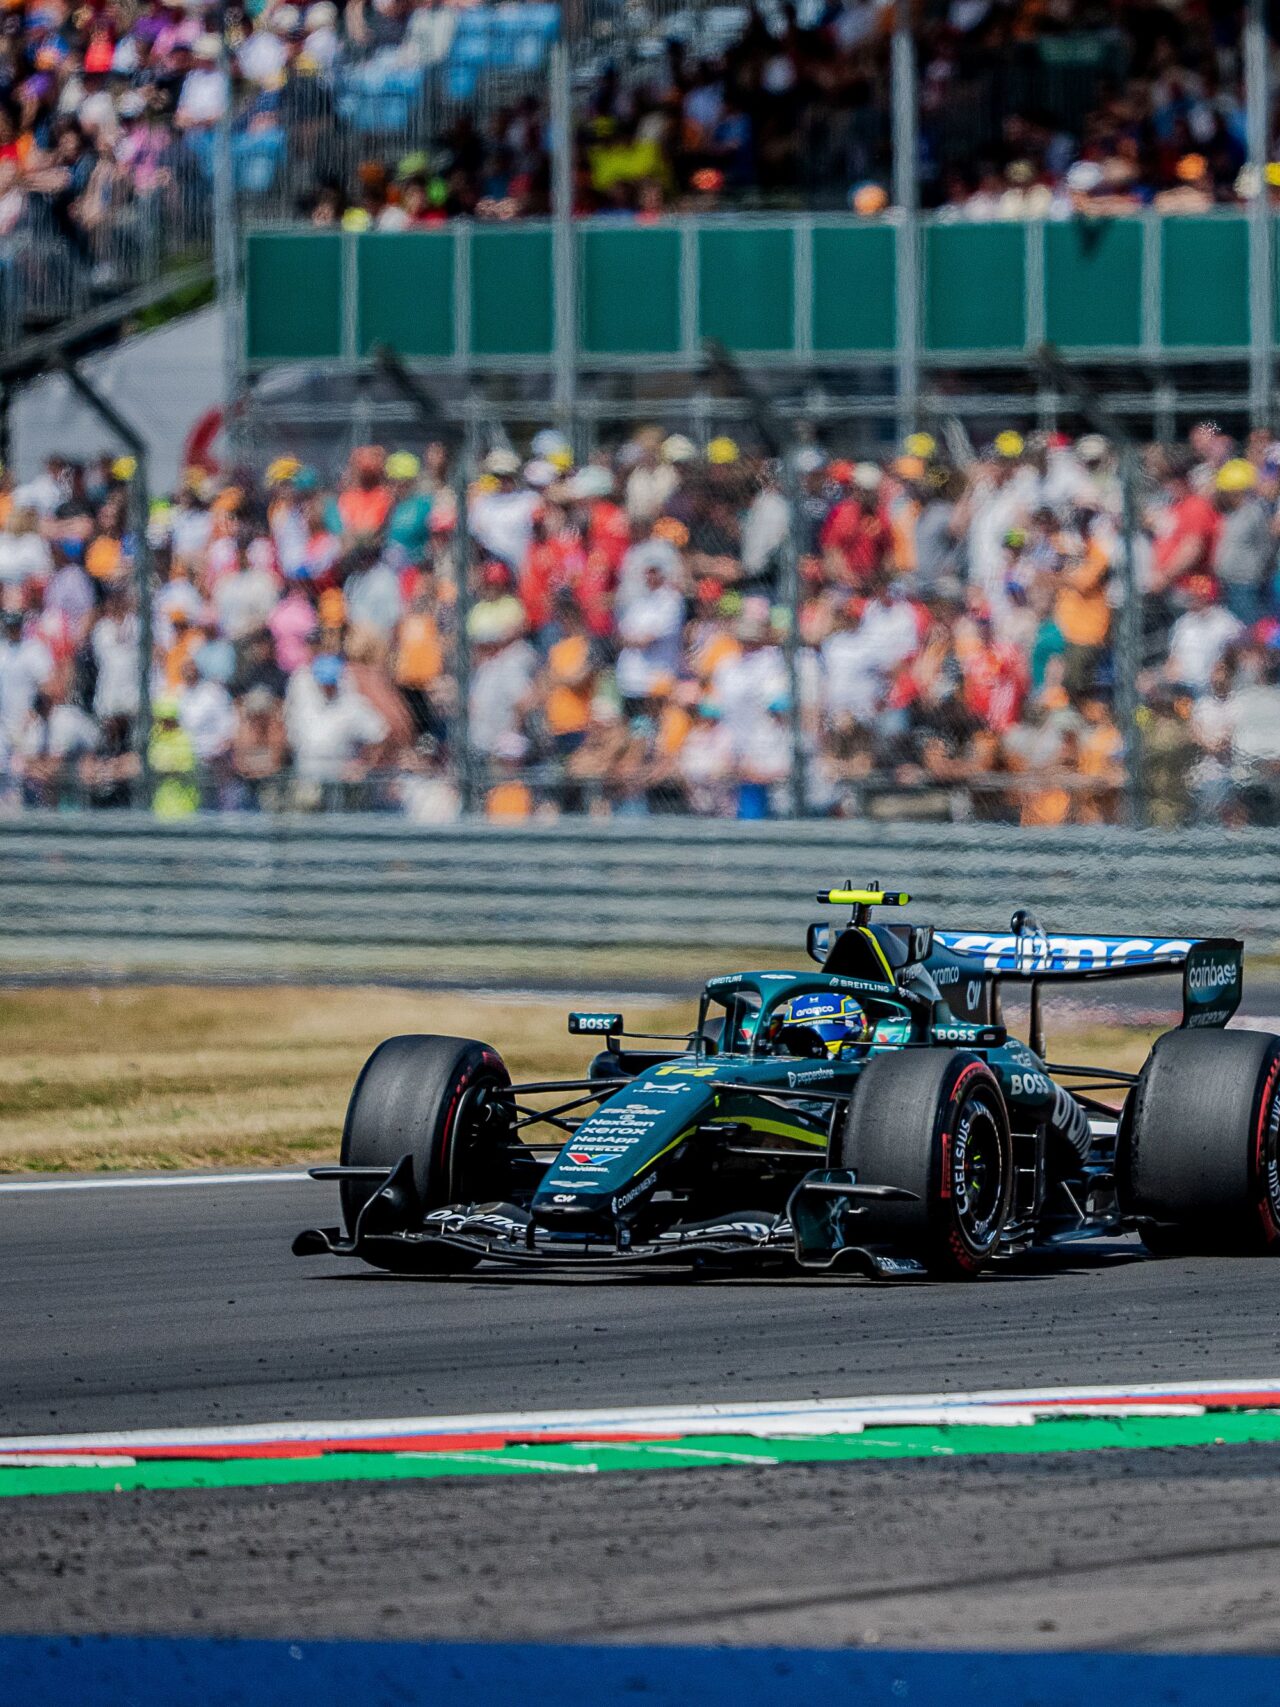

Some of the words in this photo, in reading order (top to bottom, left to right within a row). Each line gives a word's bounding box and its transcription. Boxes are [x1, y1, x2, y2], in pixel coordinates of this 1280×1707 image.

[934, 935, 1196, 971] ramco
[931, 966, 960, 985] aramco
[1189, 958, 1237, 988] coinbase
[840, 979, 890, 993] BREITLING
[796, 1005, 834, 1017] aramco
[579, 1018, 611, 1030] BOSS
[937, 1029, 976, 1041] BOSS
[655, 1066, 719, 1077] 14
[1011, 1073, 1050, 1096] BOSS
[588, 1119, 655, 1128] NexGen
[581, 1127, 648, 1136] xerox
[573, 1136, 640, 1145] NetApp
[954, 1118, 971, 1197] CELSIUS
